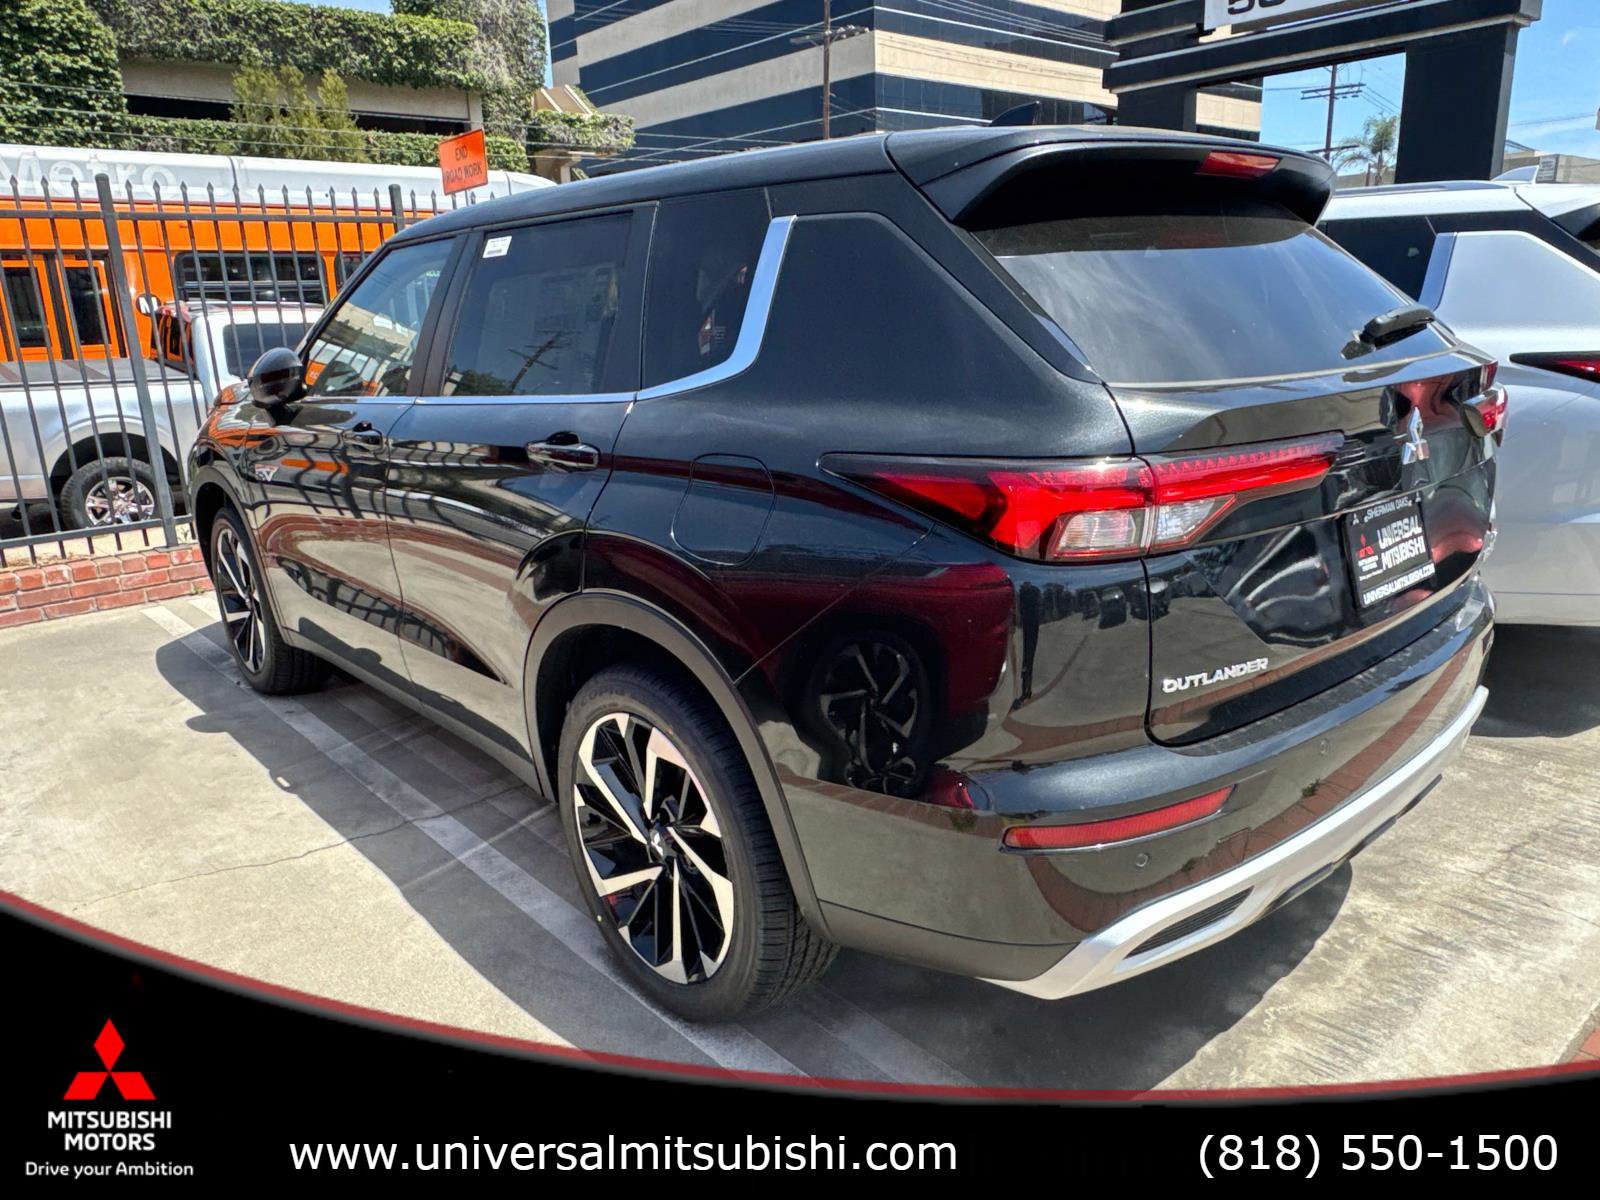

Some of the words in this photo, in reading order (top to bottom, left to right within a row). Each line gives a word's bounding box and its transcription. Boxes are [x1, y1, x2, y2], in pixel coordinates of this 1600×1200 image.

[455, 145, 468, 161] END
[0, 152, 177, 199] Metro
[445, 167, 463, 184] ROAD
[464, 161, 482, 178] WORK
[1366, 501, 1396, 519] SHERMAN
[1377, 514, 1423, 549] UNIVERSAL
[1381, 536, 1426, 570] MITSUBISHI
[1162, 658, 1269, 693] OUTLANDER
